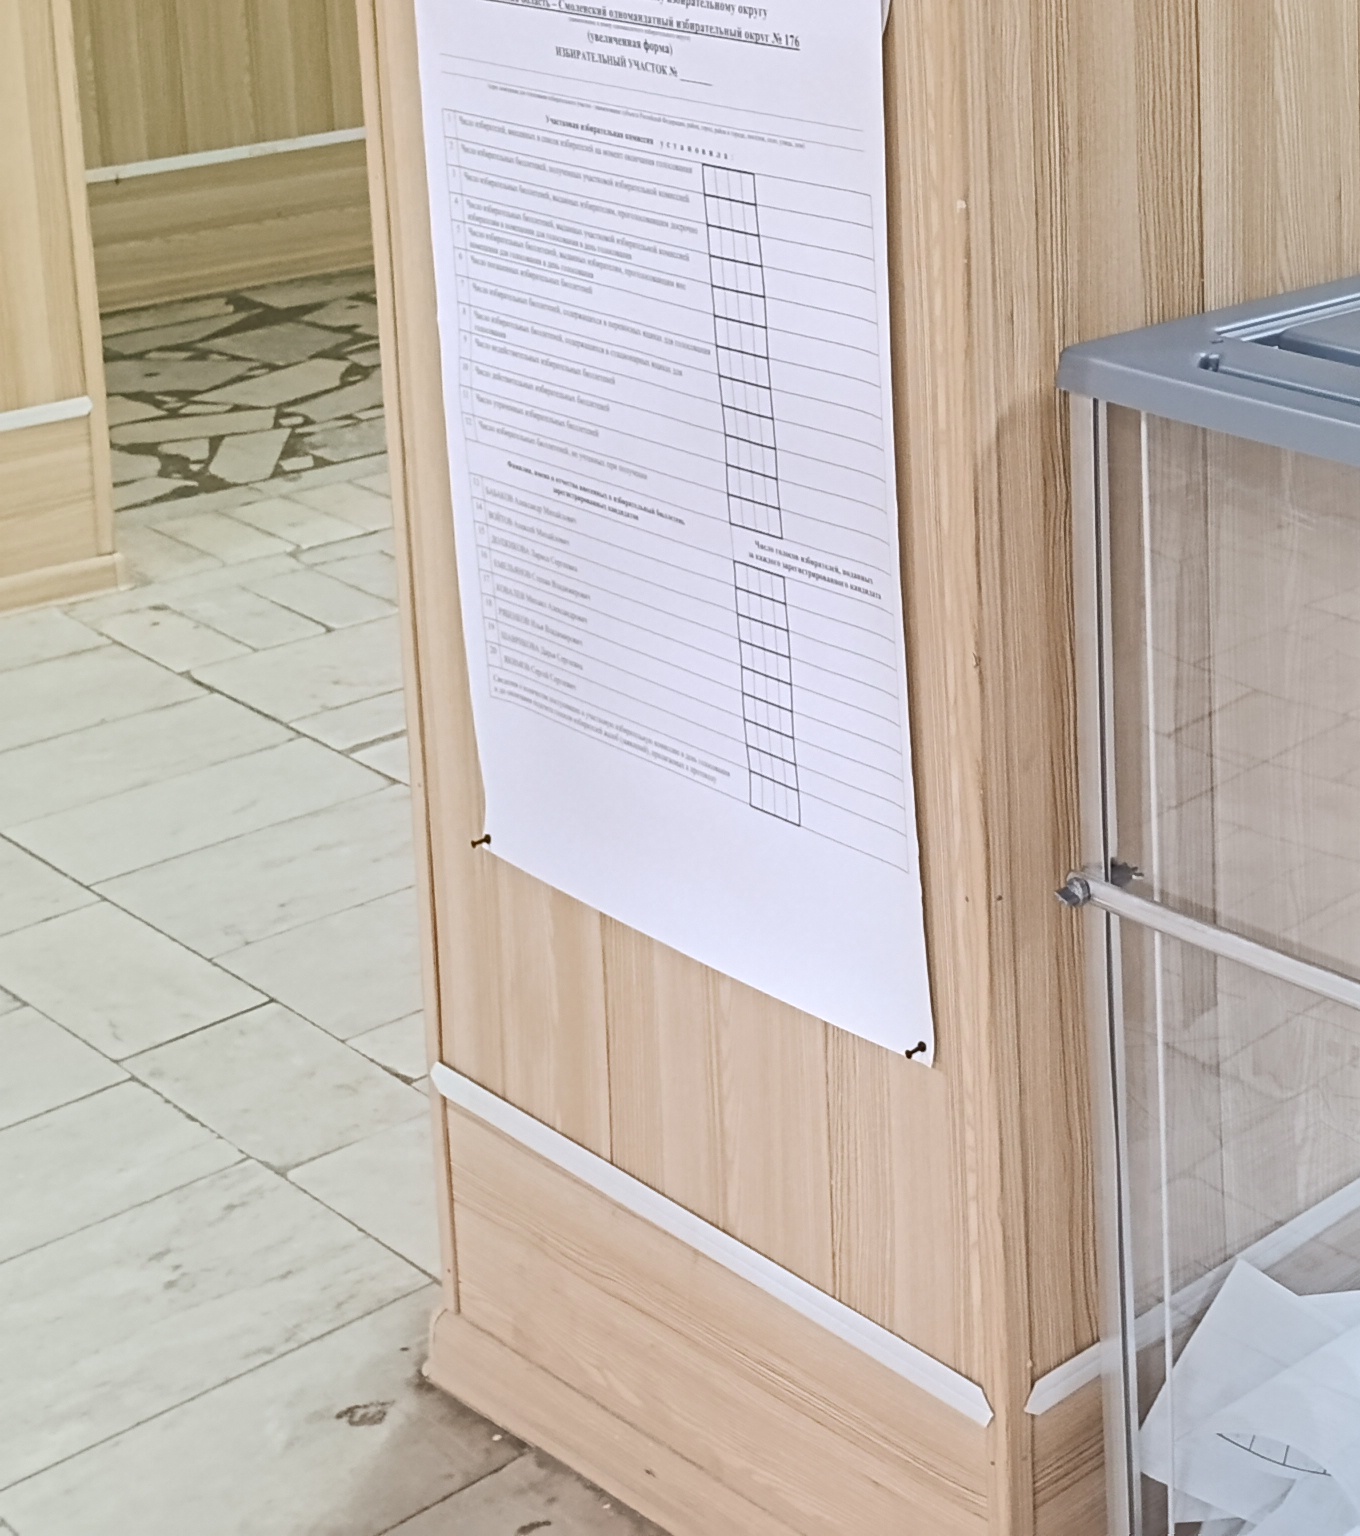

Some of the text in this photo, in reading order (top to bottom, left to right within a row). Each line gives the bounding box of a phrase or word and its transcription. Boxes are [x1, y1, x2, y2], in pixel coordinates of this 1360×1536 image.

[737, 5, 767, 20] округу
[784, 33, 799, 48] 176
[555, 45, 626, 68] ИЗБИРАТЕЛЬНЫЙ
[628, 58, 668, 76] УЧАСТОК
